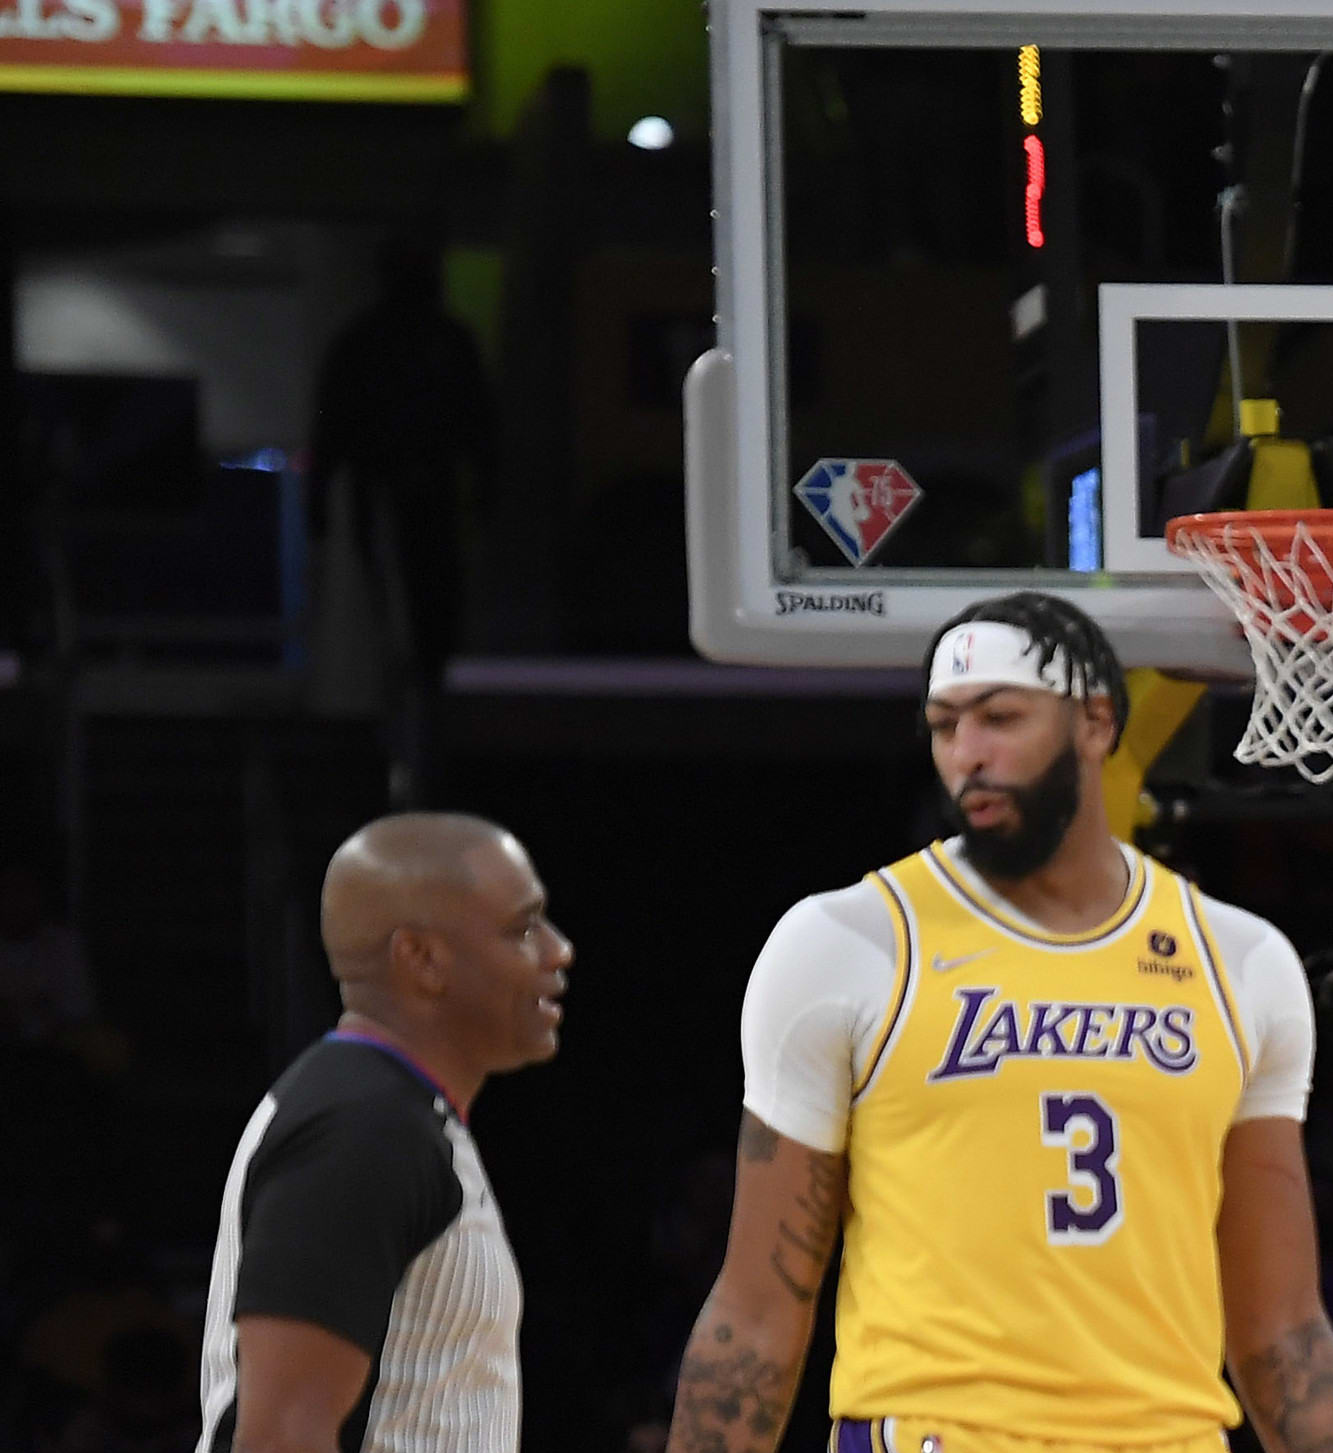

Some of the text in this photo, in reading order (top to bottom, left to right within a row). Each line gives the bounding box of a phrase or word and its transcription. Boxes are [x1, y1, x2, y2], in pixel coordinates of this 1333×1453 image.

[776, 592, 885, 617] SPALDING
[1137, 957, 1194, 982] bibigo
[926, 986, 1197, 1085] LAKERS
[1039, 1091, 1124, 1245] 3
